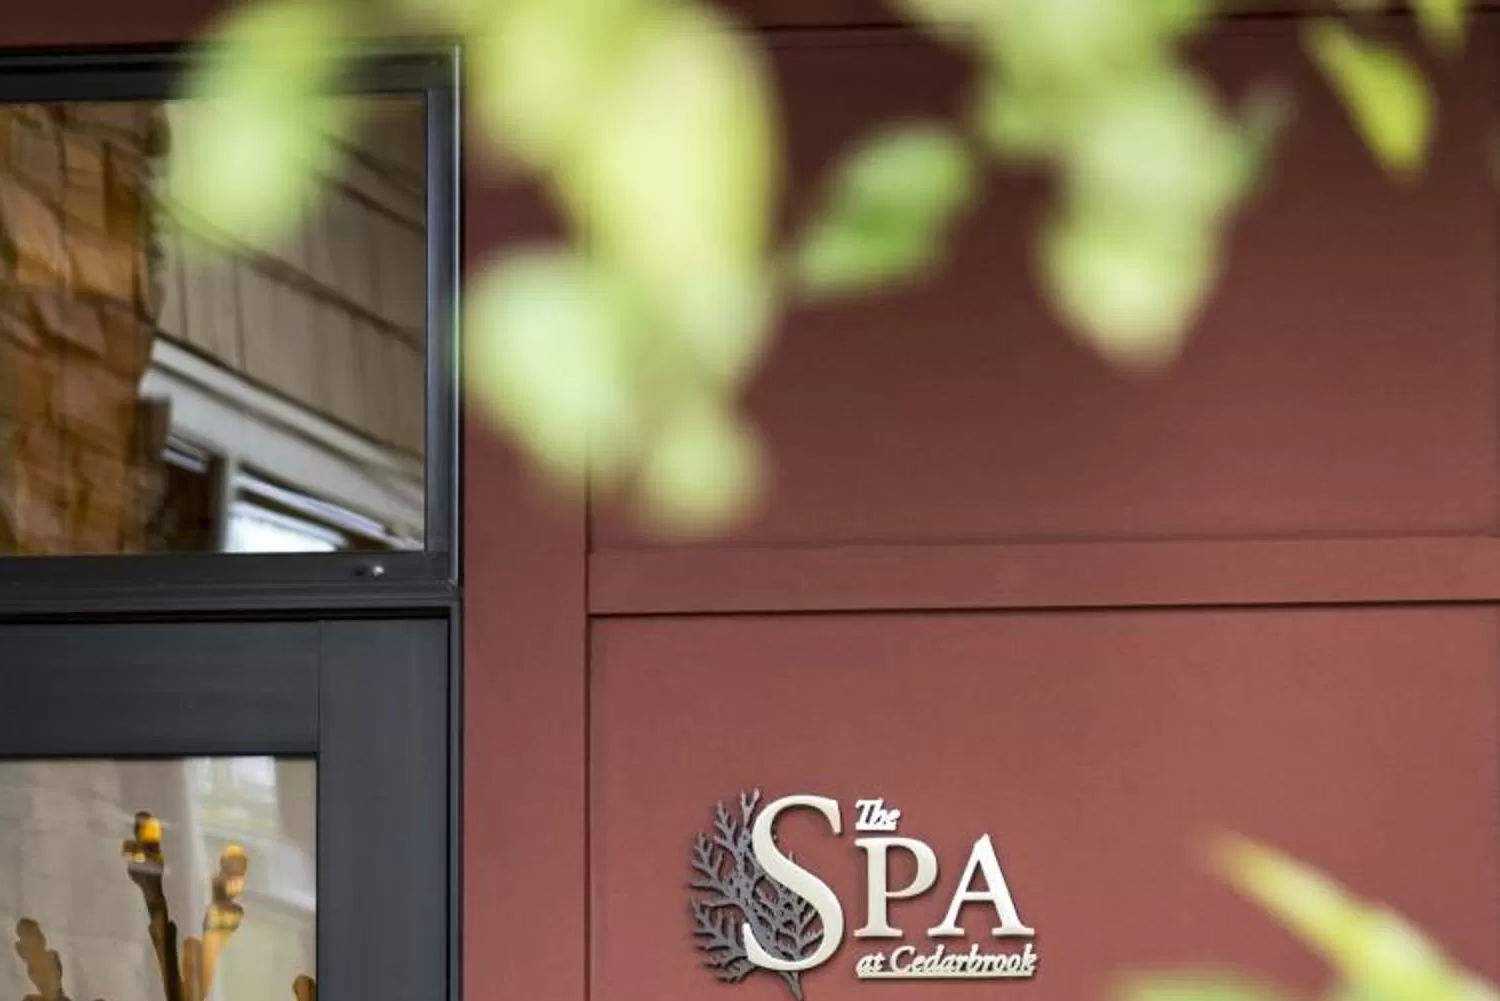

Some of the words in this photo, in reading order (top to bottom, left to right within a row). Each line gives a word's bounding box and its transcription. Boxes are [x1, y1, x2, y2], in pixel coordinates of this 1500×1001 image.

[855, 798, 900, 829] The
[742, 795, 1035, 970] SPA
[856, 955, 883, 973] at
[890, 943, 1036, 973] Cedarbrook
